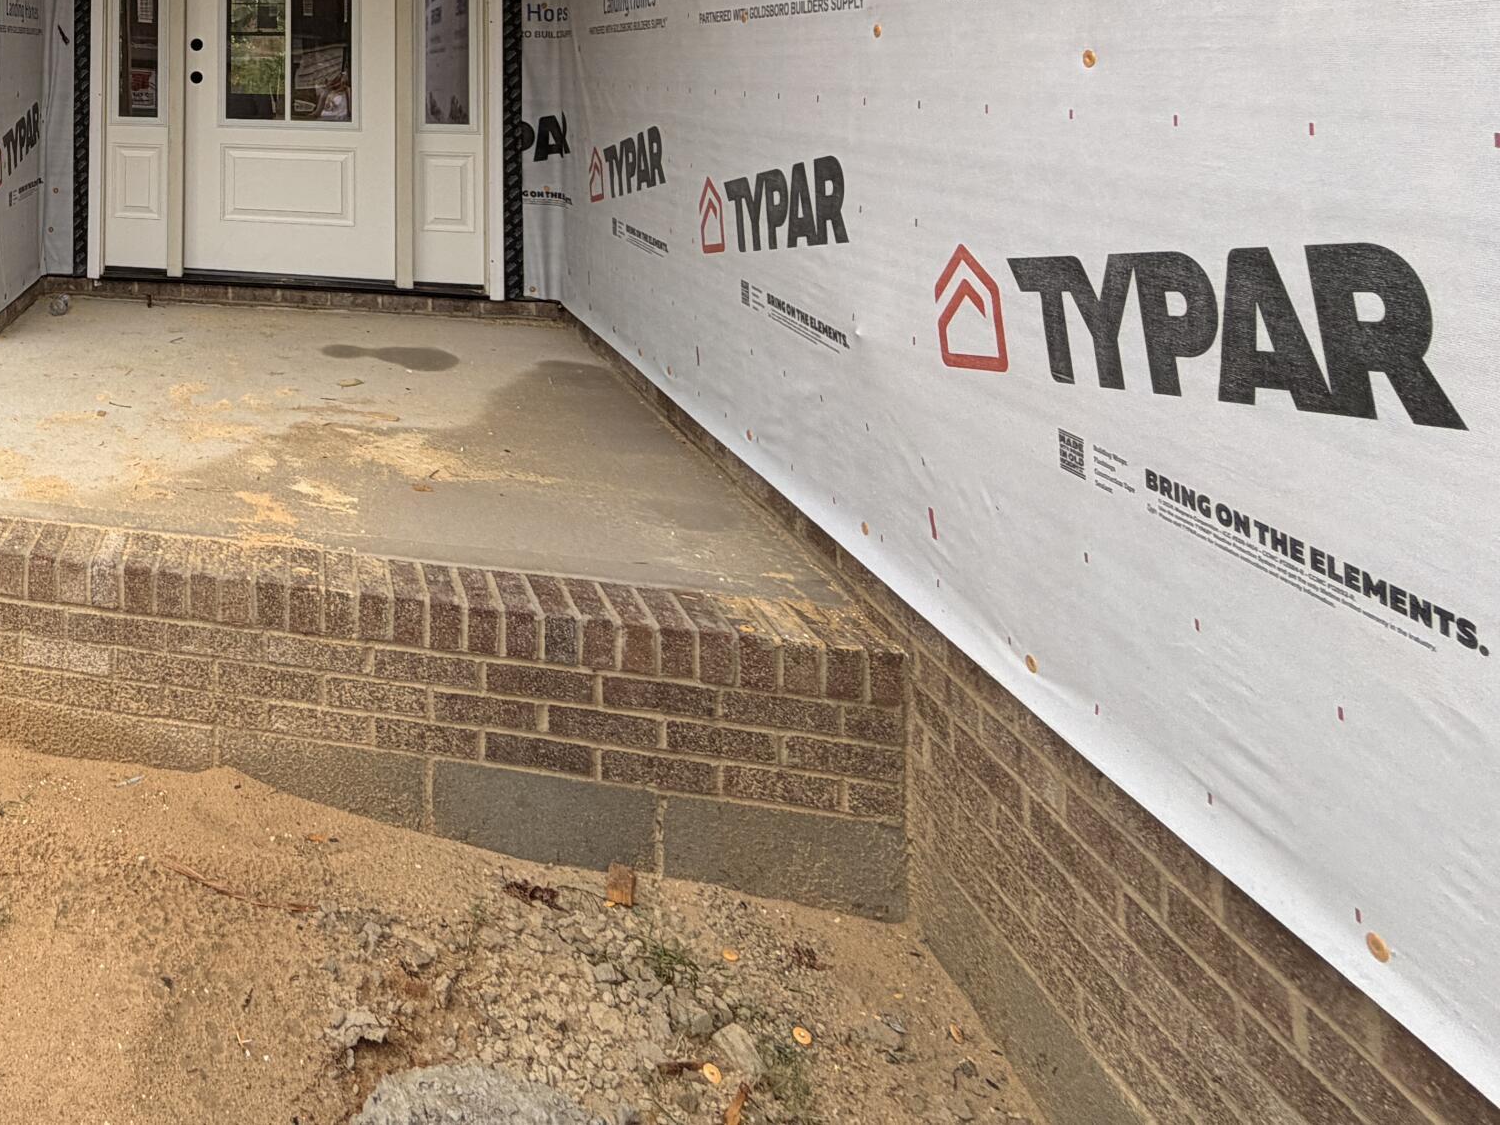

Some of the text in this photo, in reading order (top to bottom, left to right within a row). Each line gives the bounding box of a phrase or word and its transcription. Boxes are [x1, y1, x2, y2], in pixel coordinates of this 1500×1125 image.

[2, 102, 40, 176] TYPAR
[603, 125, 666, 198] TYPAR
[723, 155, 850, 252] TYPAR
[766, 293, 786, 314] BRING
[786, 303, 796, 317] ON
[796, 307, 810, 326] THE
[1007, 242, 1469, 431] TYPAR
[1145, 468, 1212, 518] BRING
[1215, 503, 1251, 538] ON
[1254, 519, 1305, 565] THE
[1310, 546, 1489, 656] ELEMENTS.
